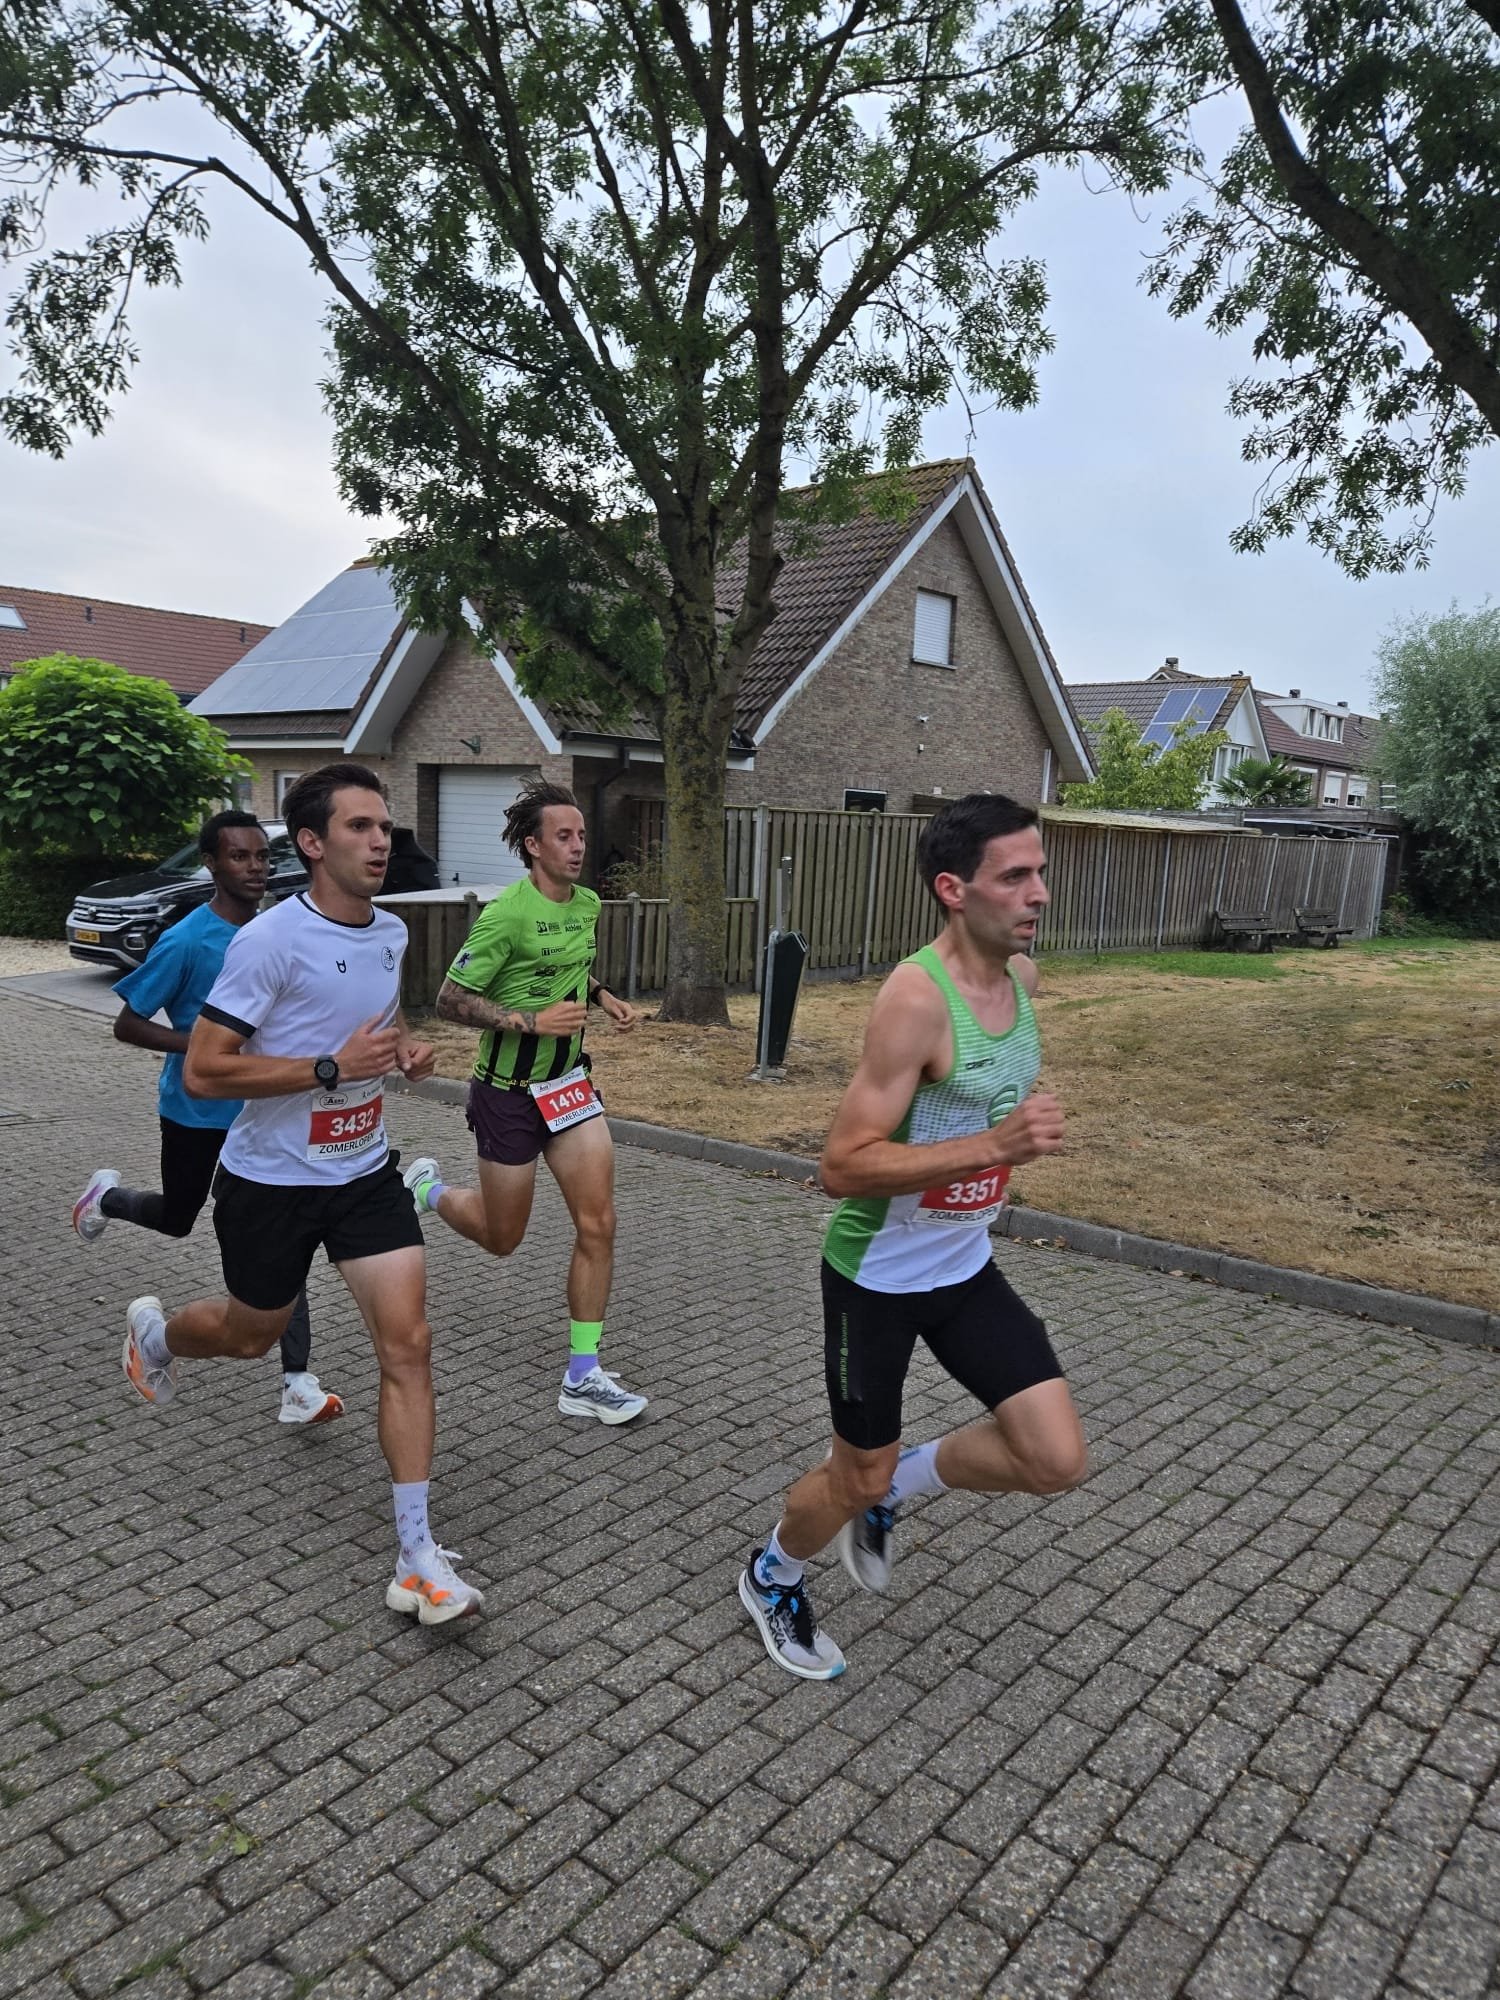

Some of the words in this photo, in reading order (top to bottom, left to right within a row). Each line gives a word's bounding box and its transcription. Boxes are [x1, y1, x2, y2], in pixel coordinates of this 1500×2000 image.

[549, 1087, 585, 1113] 1416
[330, 1107, 374, 1137] 3432
[554, 1103, 597, 1127] ZOMERLOPEN
[319, 1131, 375, 1154] ZOMERLOPEN
[944, 1175, 999, 1204] 3351
[764, 1606, 787, 1649] HOKA
